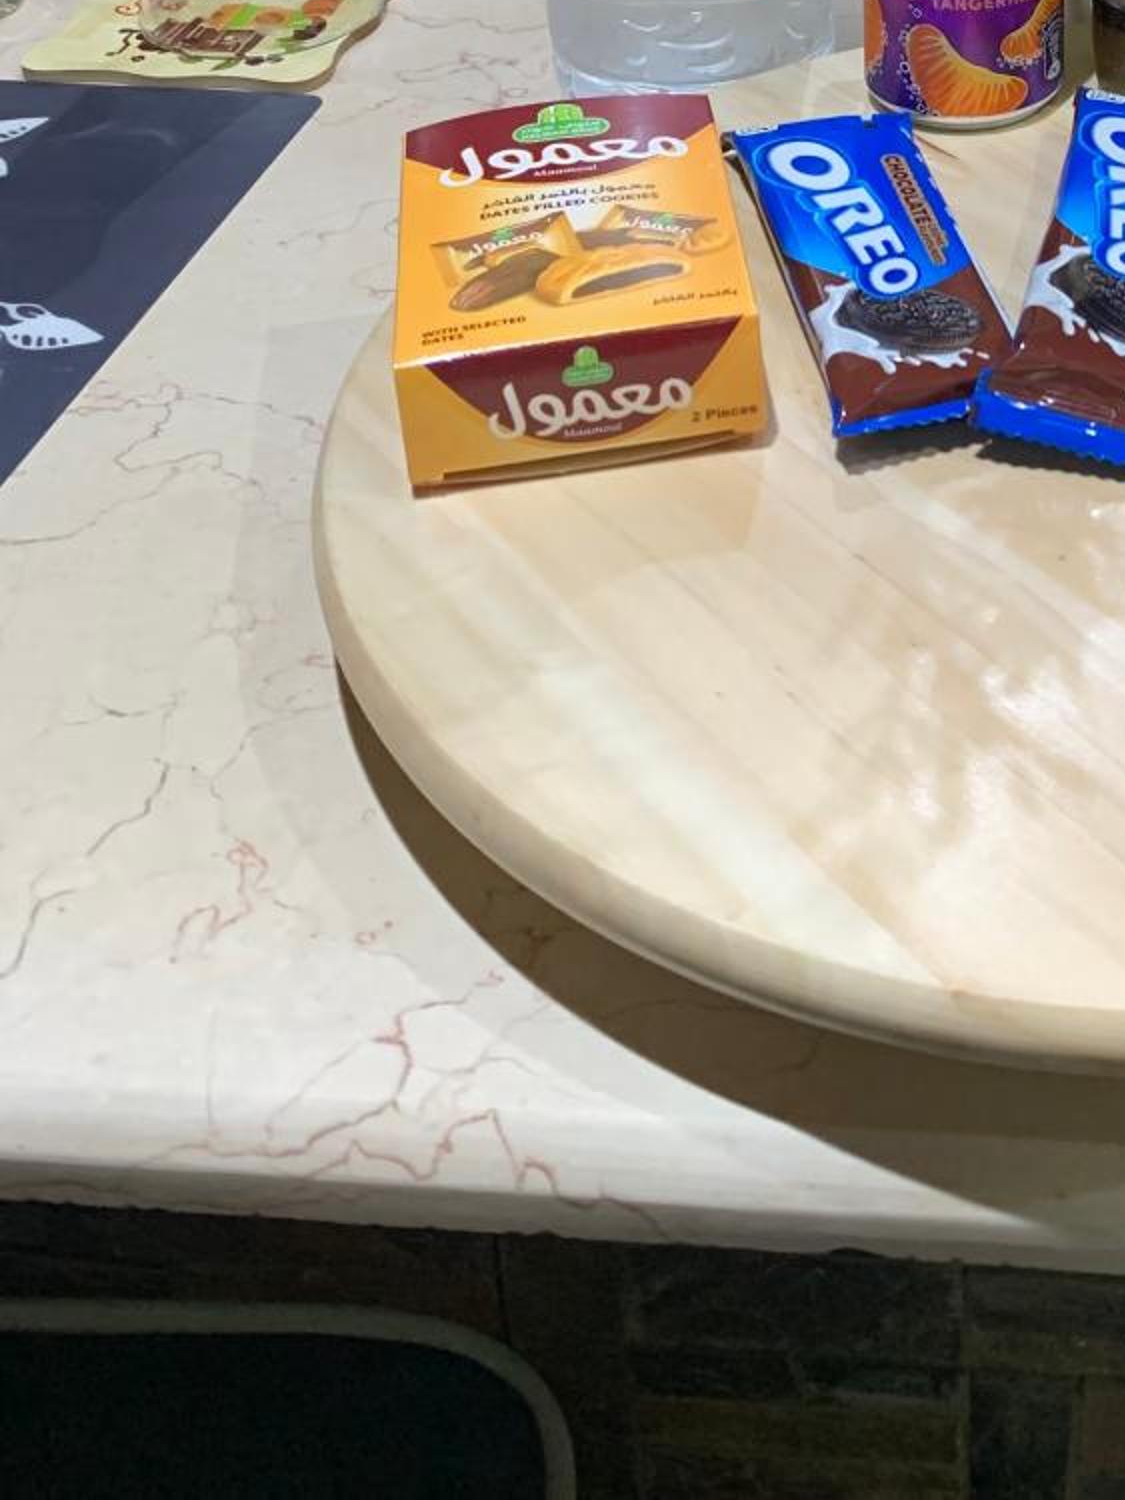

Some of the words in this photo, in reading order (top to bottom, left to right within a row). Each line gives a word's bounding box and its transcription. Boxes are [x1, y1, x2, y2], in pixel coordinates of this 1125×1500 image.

[438, 137, 689, 188] معمول
[480, 204, 530, 220] DATES
[534, 197, 586, 211] FILLED
[590, 190, 661, 205] COOKIES
[884, 155, 933, 227] CHOCOLATE
[765, 140, 919, 295] OREO
[422, 334, 464, 346] DATES
[462, 315, 527, 330] SELECTED
[487, 377, 697, 438] معمول
[691, 410, 702, 423] 2
[705, 404, 759, 421] Pieces
